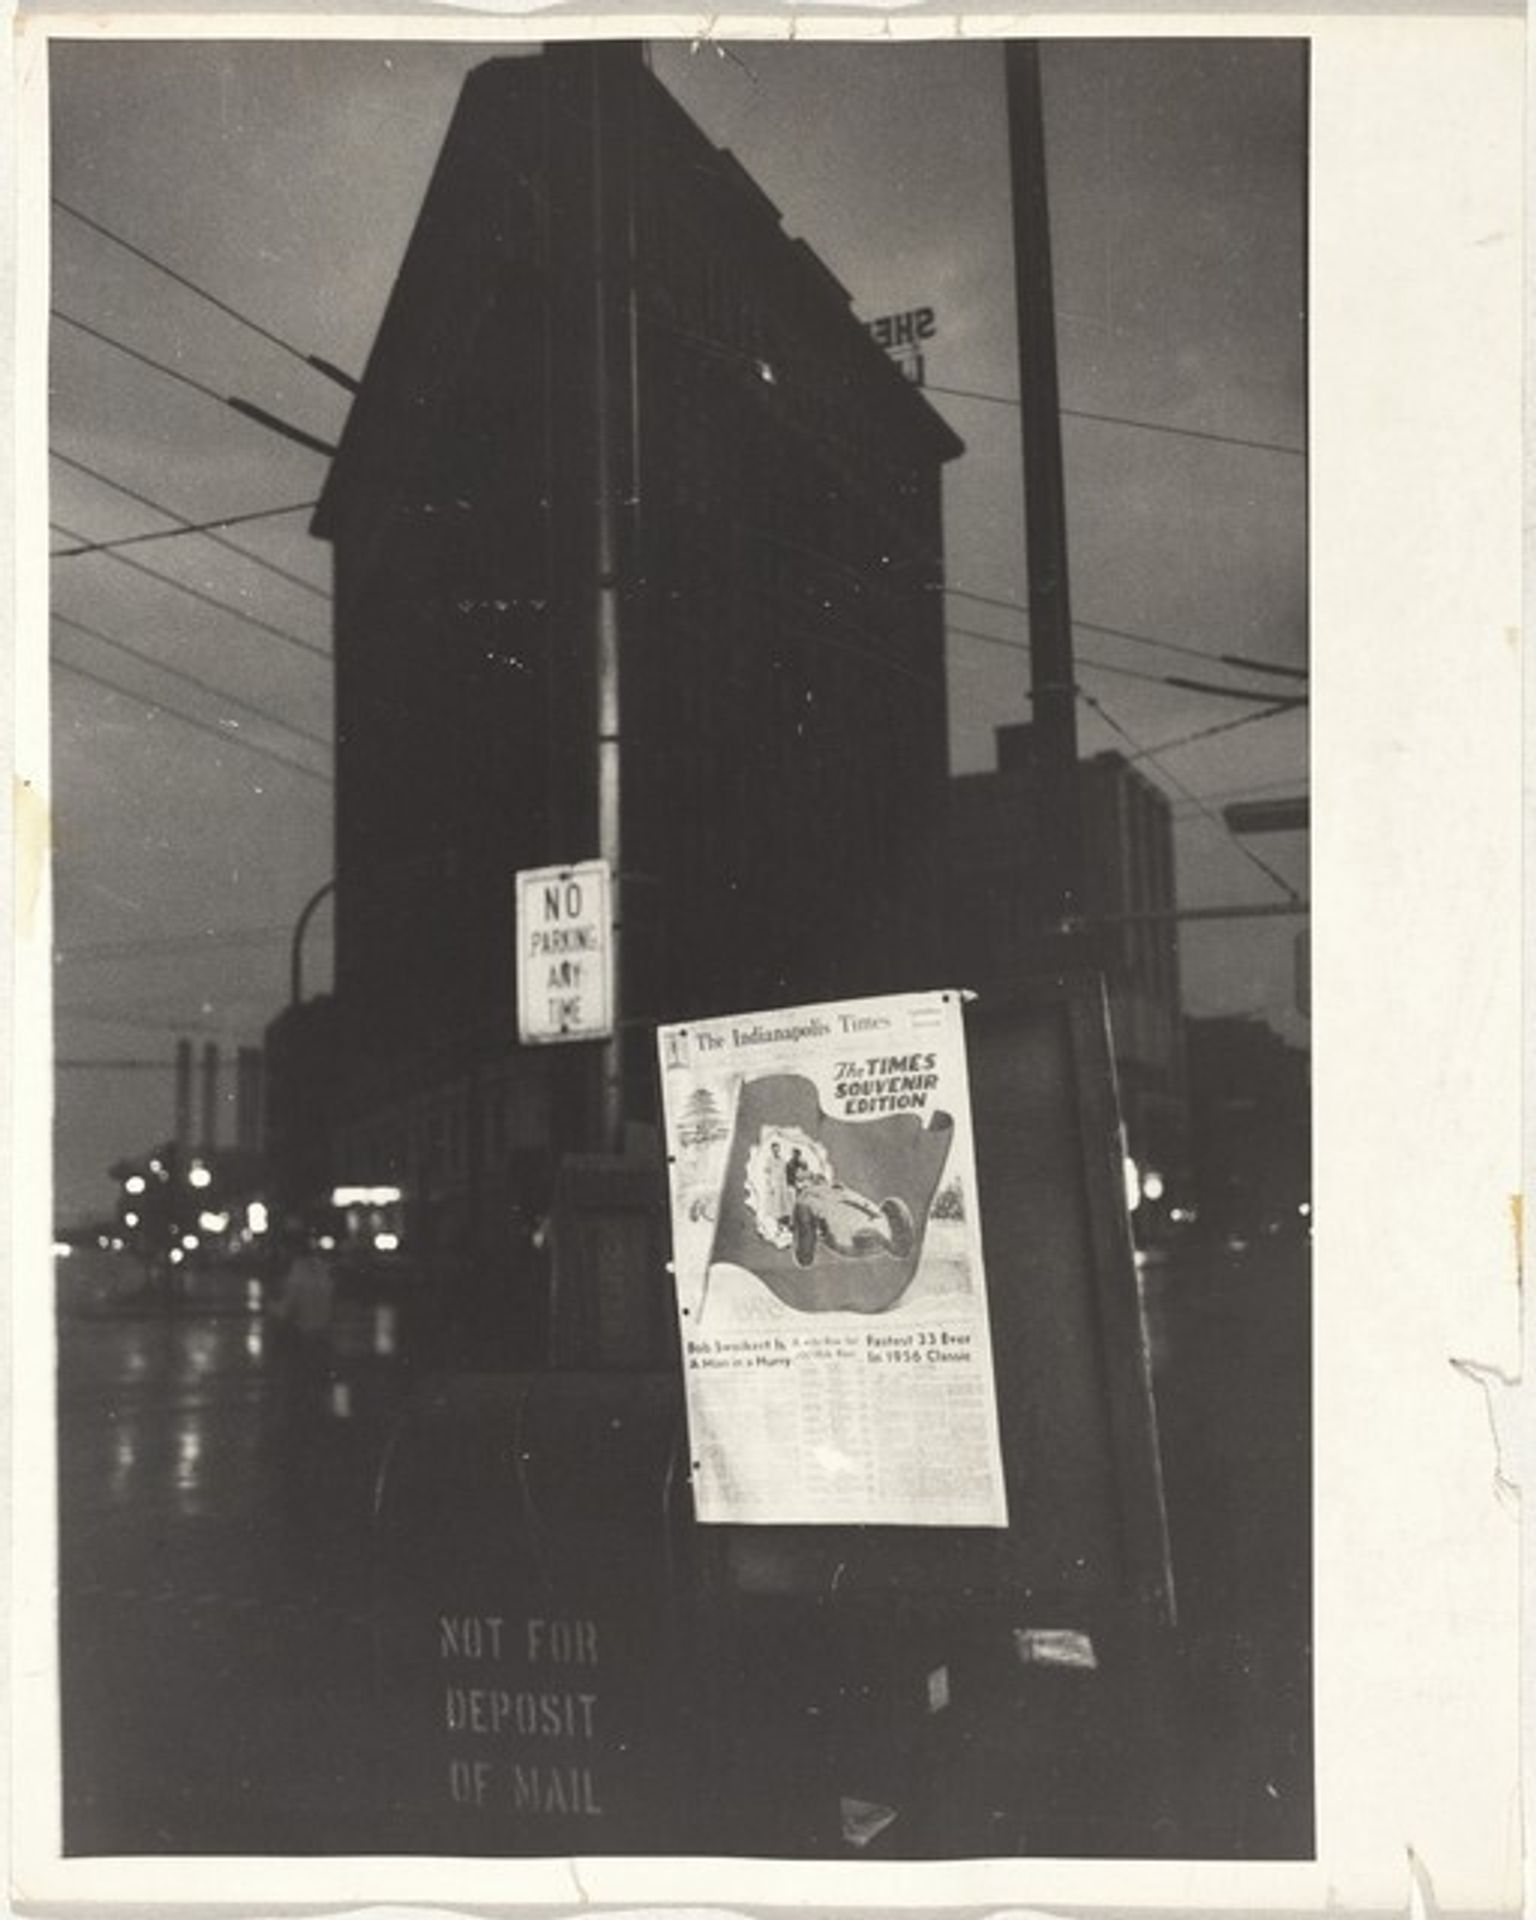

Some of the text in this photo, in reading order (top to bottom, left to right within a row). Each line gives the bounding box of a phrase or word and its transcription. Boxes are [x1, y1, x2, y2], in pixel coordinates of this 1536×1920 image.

[545, 883, 582, 921] NO
[531, 926, 598, 957] PARKING
[548, 961, 581, 989] ANY
[549, 997, 582, 1025] TIME
[696, 1032, 724, 1050] The
[731, 1018, 831, 1047] Indianapolis
[838, 1014, 891, 1033] Times
[834, 1053, 937, 1081] The TIMES
[834, 1074, 939, 1099] SOUVENIR
[845, 1092, 928, 1115] EDITION
[687, 1340, 711, 1354] Bob
[866, 1333, 913, 1348] Fastest
[917, 1331, 937, 1346] 33
[941, 1331, 970, 1345] Ever
[755, 1355, 791, 1370] Hurry
[885, 1349, 922, 1363] 1956
[926, 1349, 970, 1363] Classic
[440, 1615, 598, 1667] NOT FOR
[446, 1685, 598, 1738] DEPOSIT
[450, 1761, 602, 1816] OF MAIL
